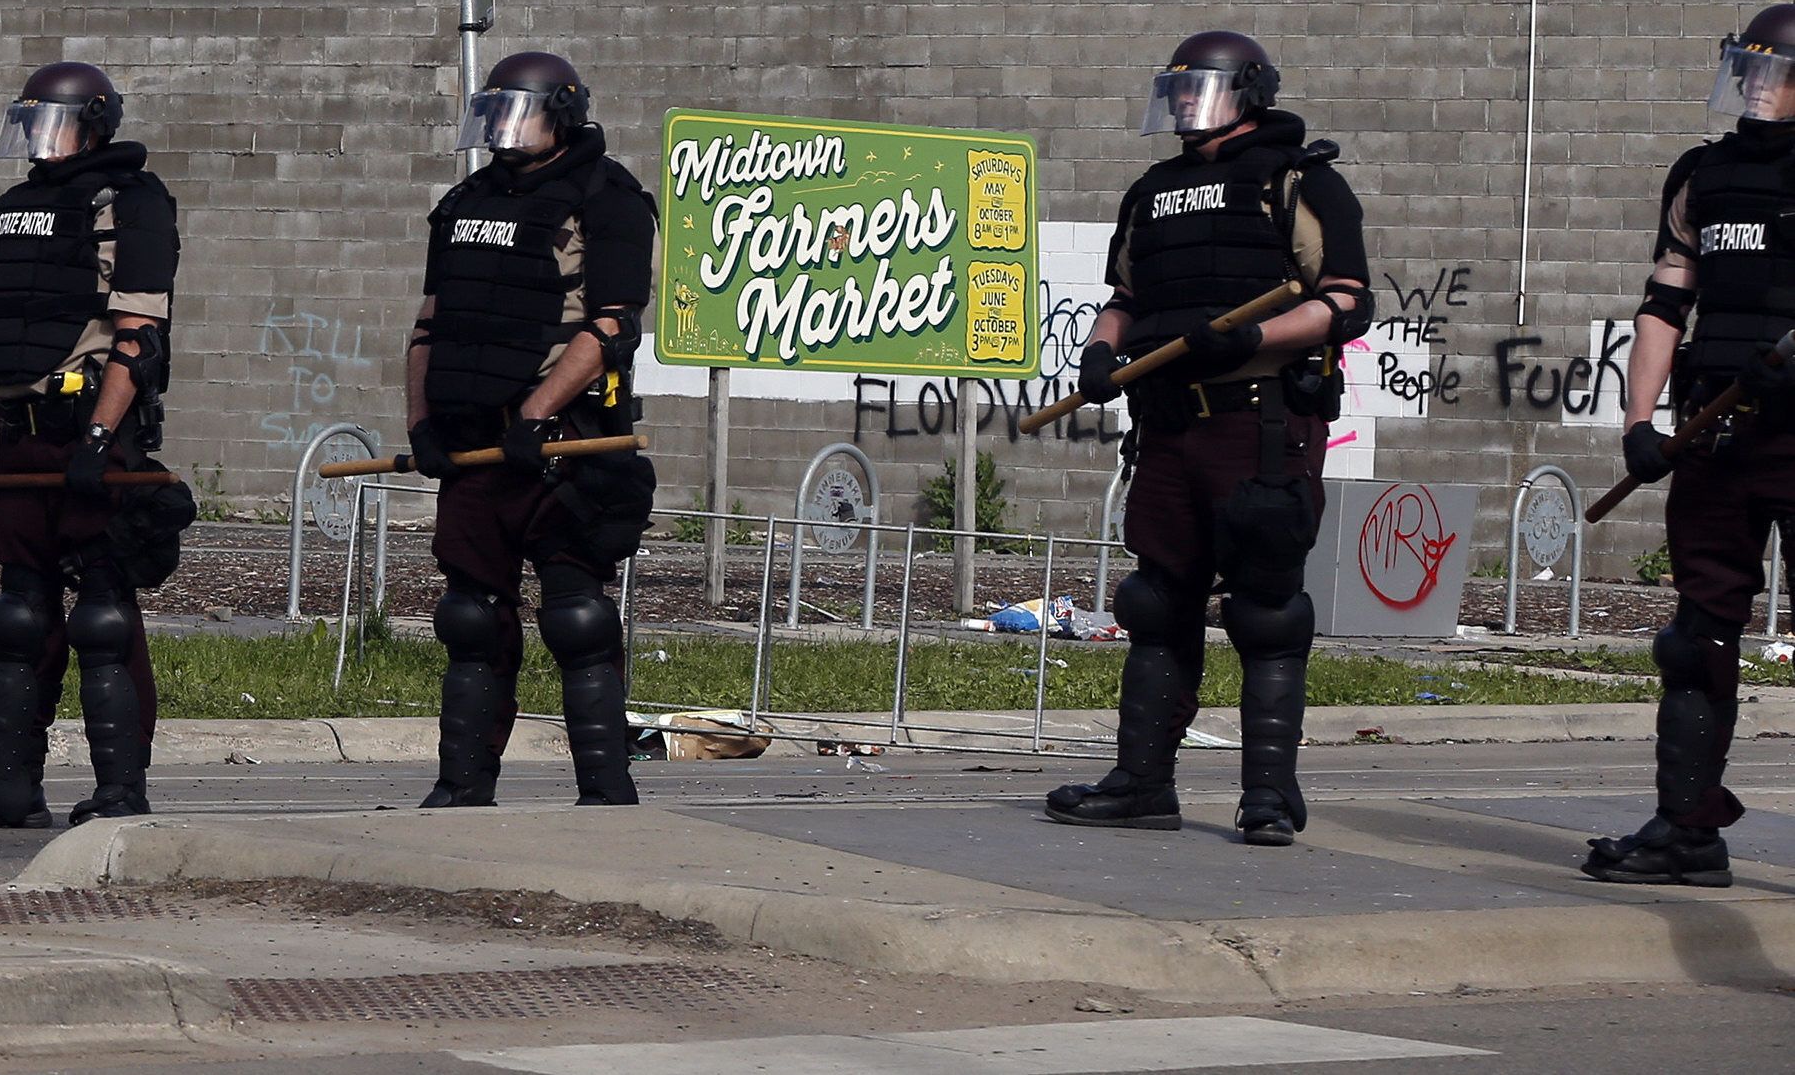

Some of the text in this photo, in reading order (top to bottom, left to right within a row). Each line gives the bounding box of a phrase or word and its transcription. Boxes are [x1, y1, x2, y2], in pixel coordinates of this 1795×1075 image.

[670, 130, 846, 201] Midtown
[972, 158, 1022, 183] SATURDAYS
[984, 183, 1007, 195] MAY
[1152, 183, 1226, 219] STATE PATROL
[17, 212, 55, 236] PATROL
[979, 208, 1014, 222] OCTOBER
[451, 218, 517, 246] STATE PATROL
[700, 186, 957, 290] Farmers
[1720, 223, 1766, 250] PATROL
[972, 268, 1020, 292] TUESDAYS
[1384, 268, 1471, 311] WE
[737, 255, 957, 360] Market
[981, 292, 1007, 306] JUNE
[257, 303, 373, 367] KILL
[974, 319, 1017, 334] OCTOBER
[1377, 315, 1448, 346] THE
[287, 366, 335, 412] TO
